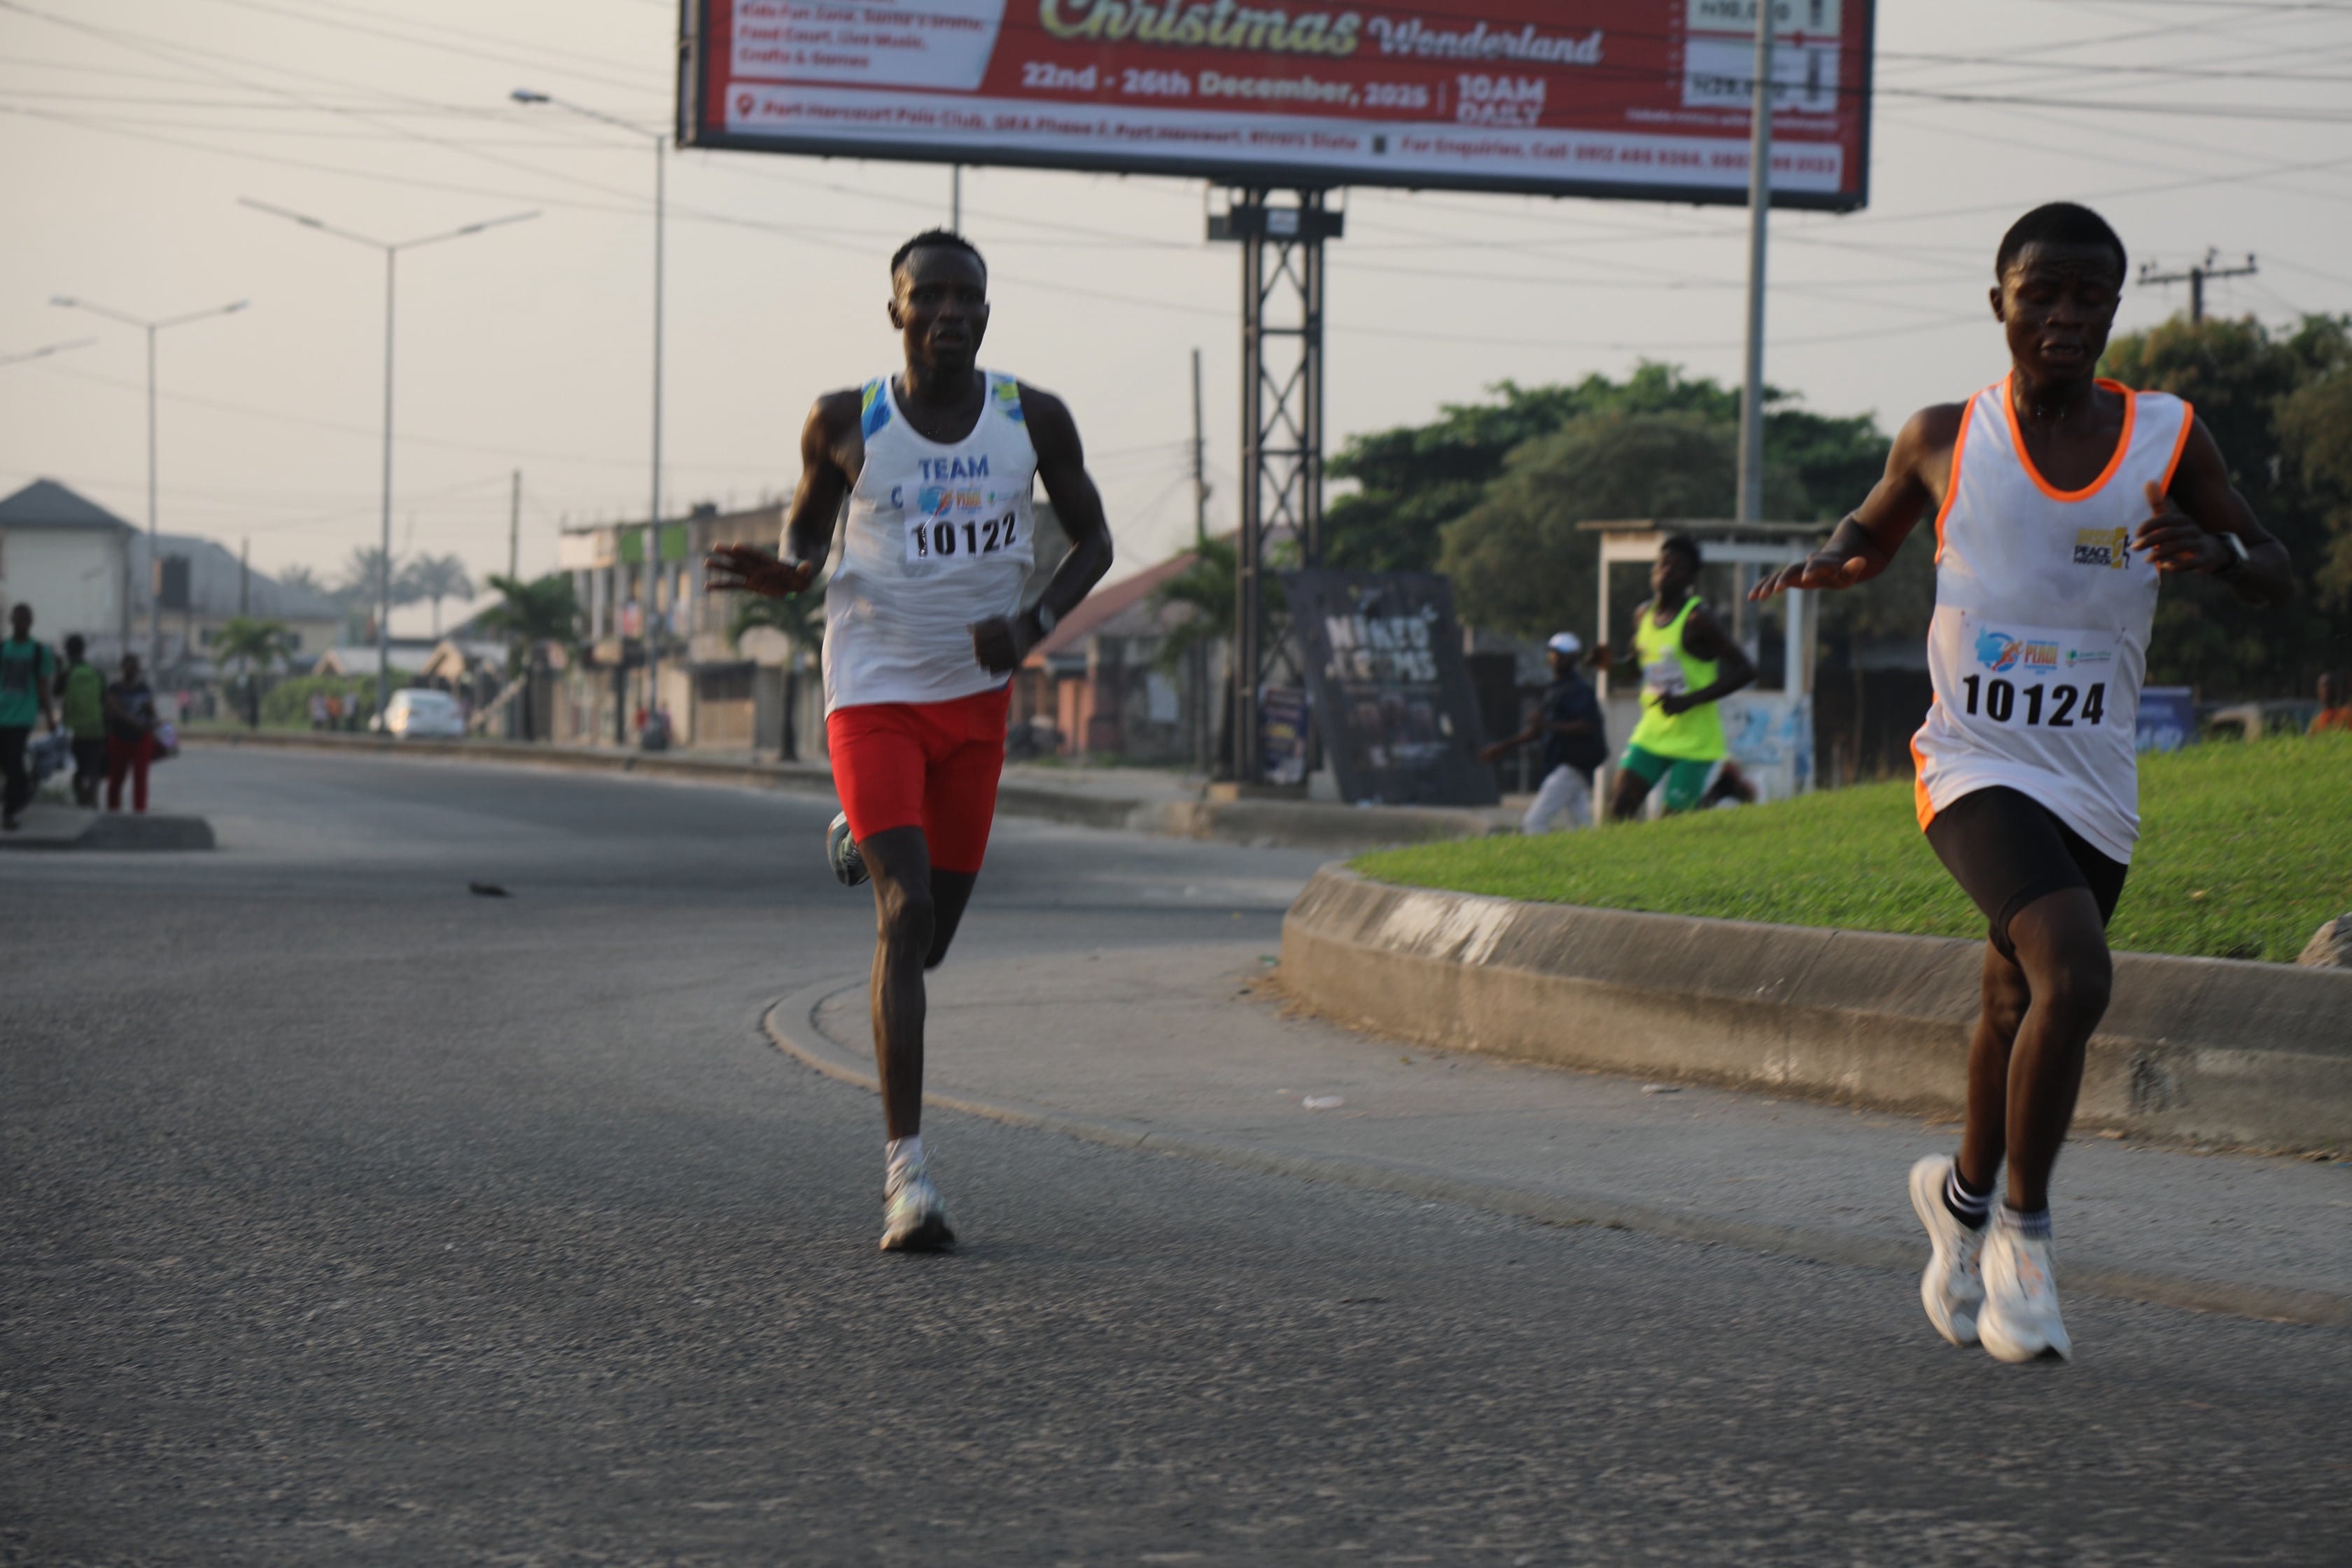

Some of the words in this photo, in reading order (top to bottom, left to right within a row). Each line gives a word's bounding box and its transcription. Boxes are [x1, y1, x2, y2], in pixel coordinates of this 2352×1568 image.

[1040, 0, 1362, 56] Christmas
[1368, 15, 1604, 64] Wonderland
[1023, 61, 1098, 90] 22nd
[1123, 68, 1190, 97] 26th
[1198, 69, 1359, 107] December,
[1456, 74, 1546, 103] 10AM
[763, 100, 803, 117] Port
[807, 103, 892, 122] Harcourt
[919, 455, 989, 479] TEAM
[911, 511, 1016, 557] 10122
[1963, 673, 2106, 727] 10124
